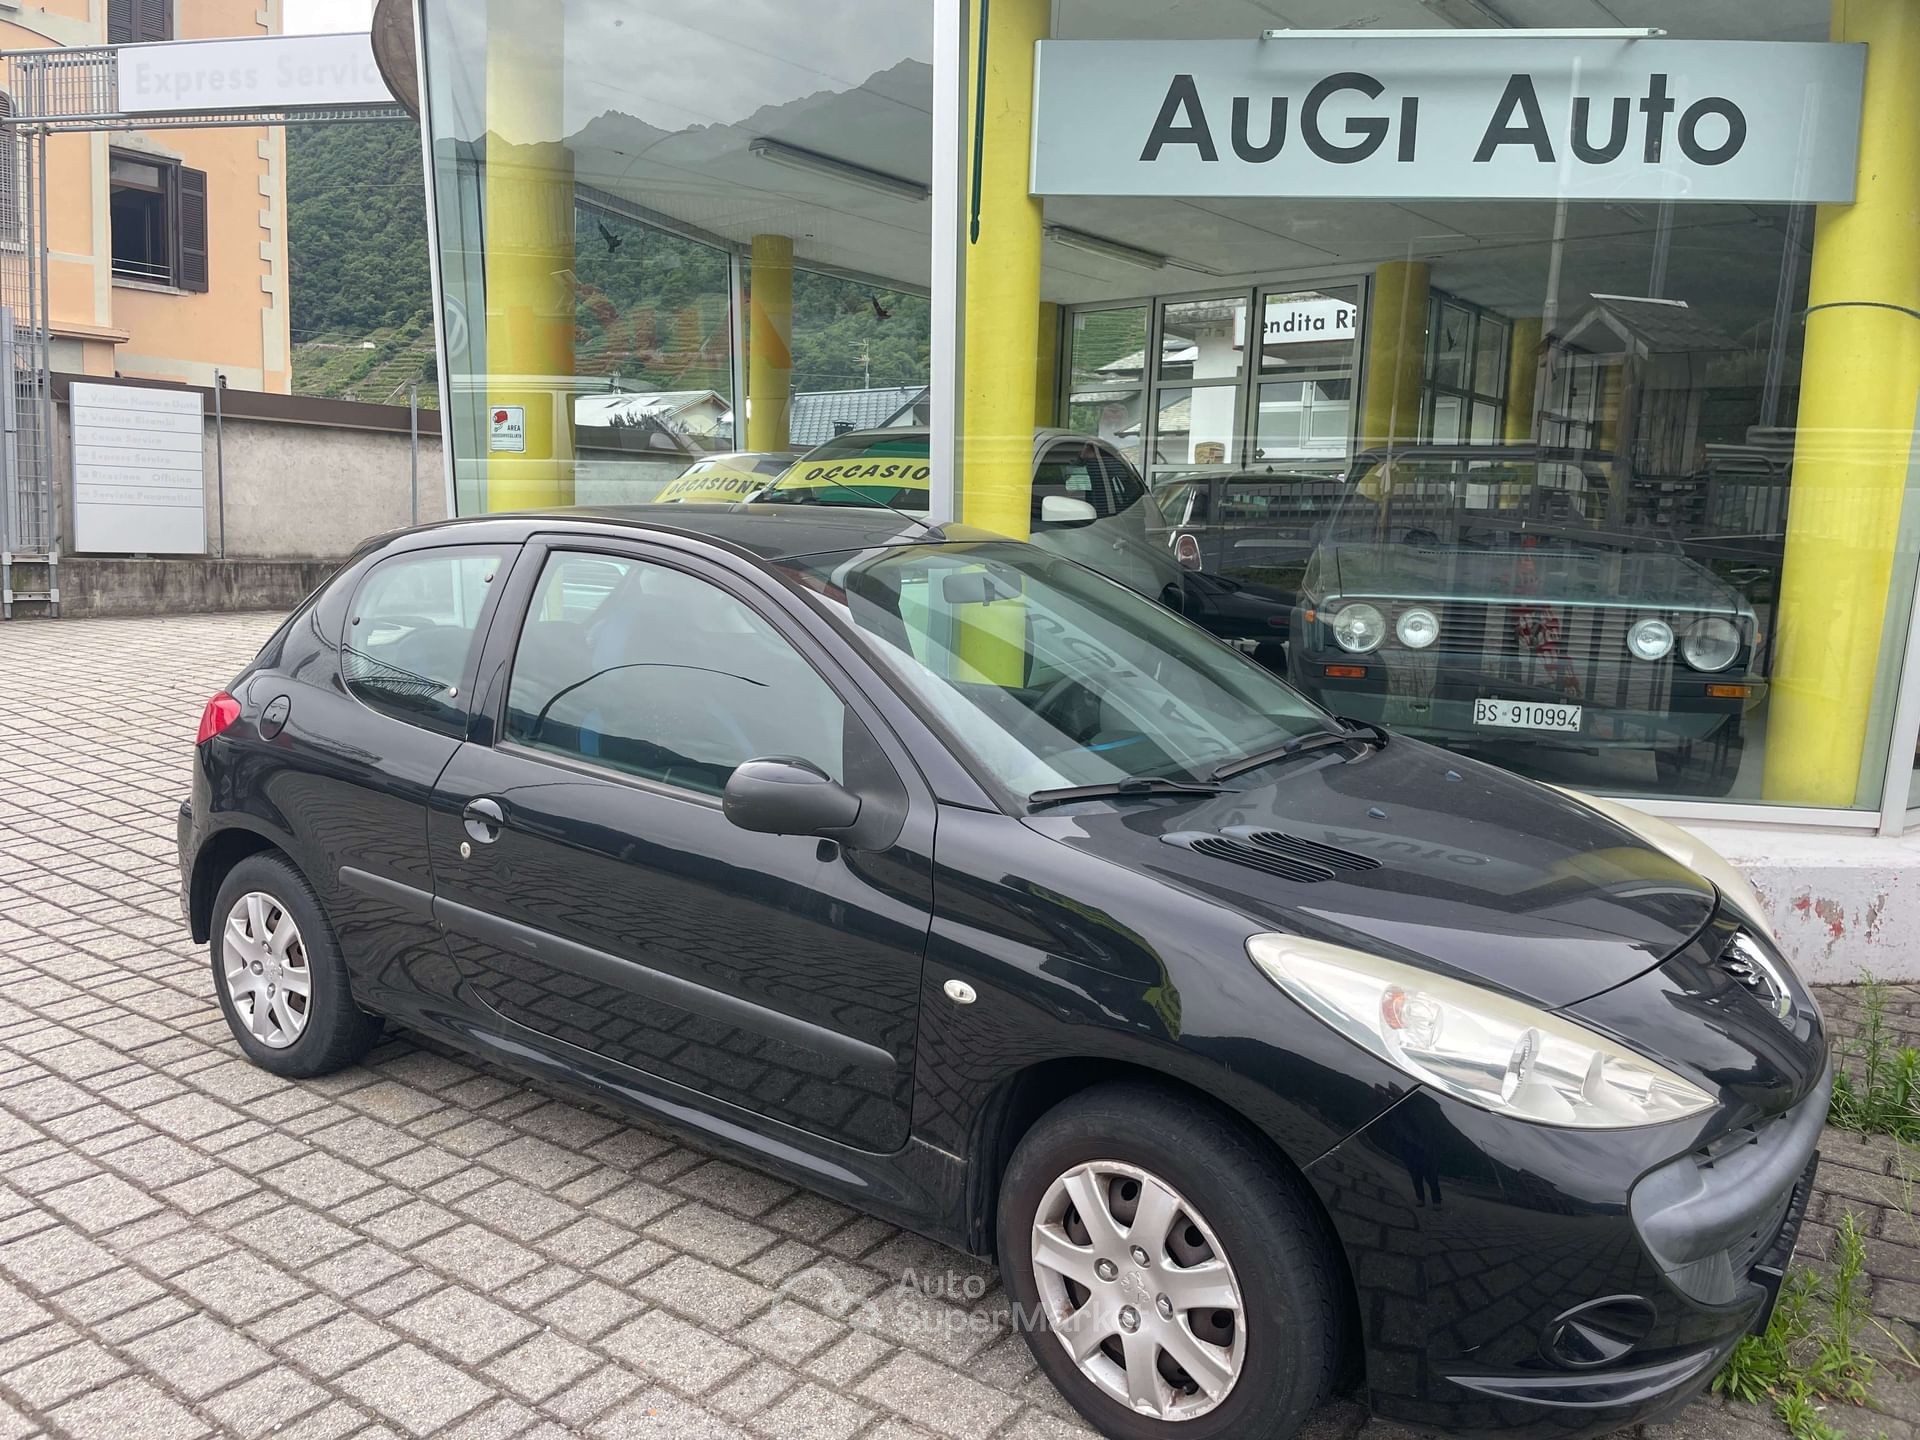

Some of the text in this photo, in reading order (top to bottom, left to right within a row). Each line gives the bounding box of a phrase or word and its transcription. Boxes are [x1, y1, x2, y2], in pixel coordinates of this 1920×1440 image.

[135, 62, 259, 101] Express
[1472, 73, 1747, 166] Auto
[1262, 312, 1325, 334] endita
[507, 424, 521, 432] AREA
[667, 477, 763, 497] OCCASIONE
[1476, 703, 1578, 728] BS 910994
